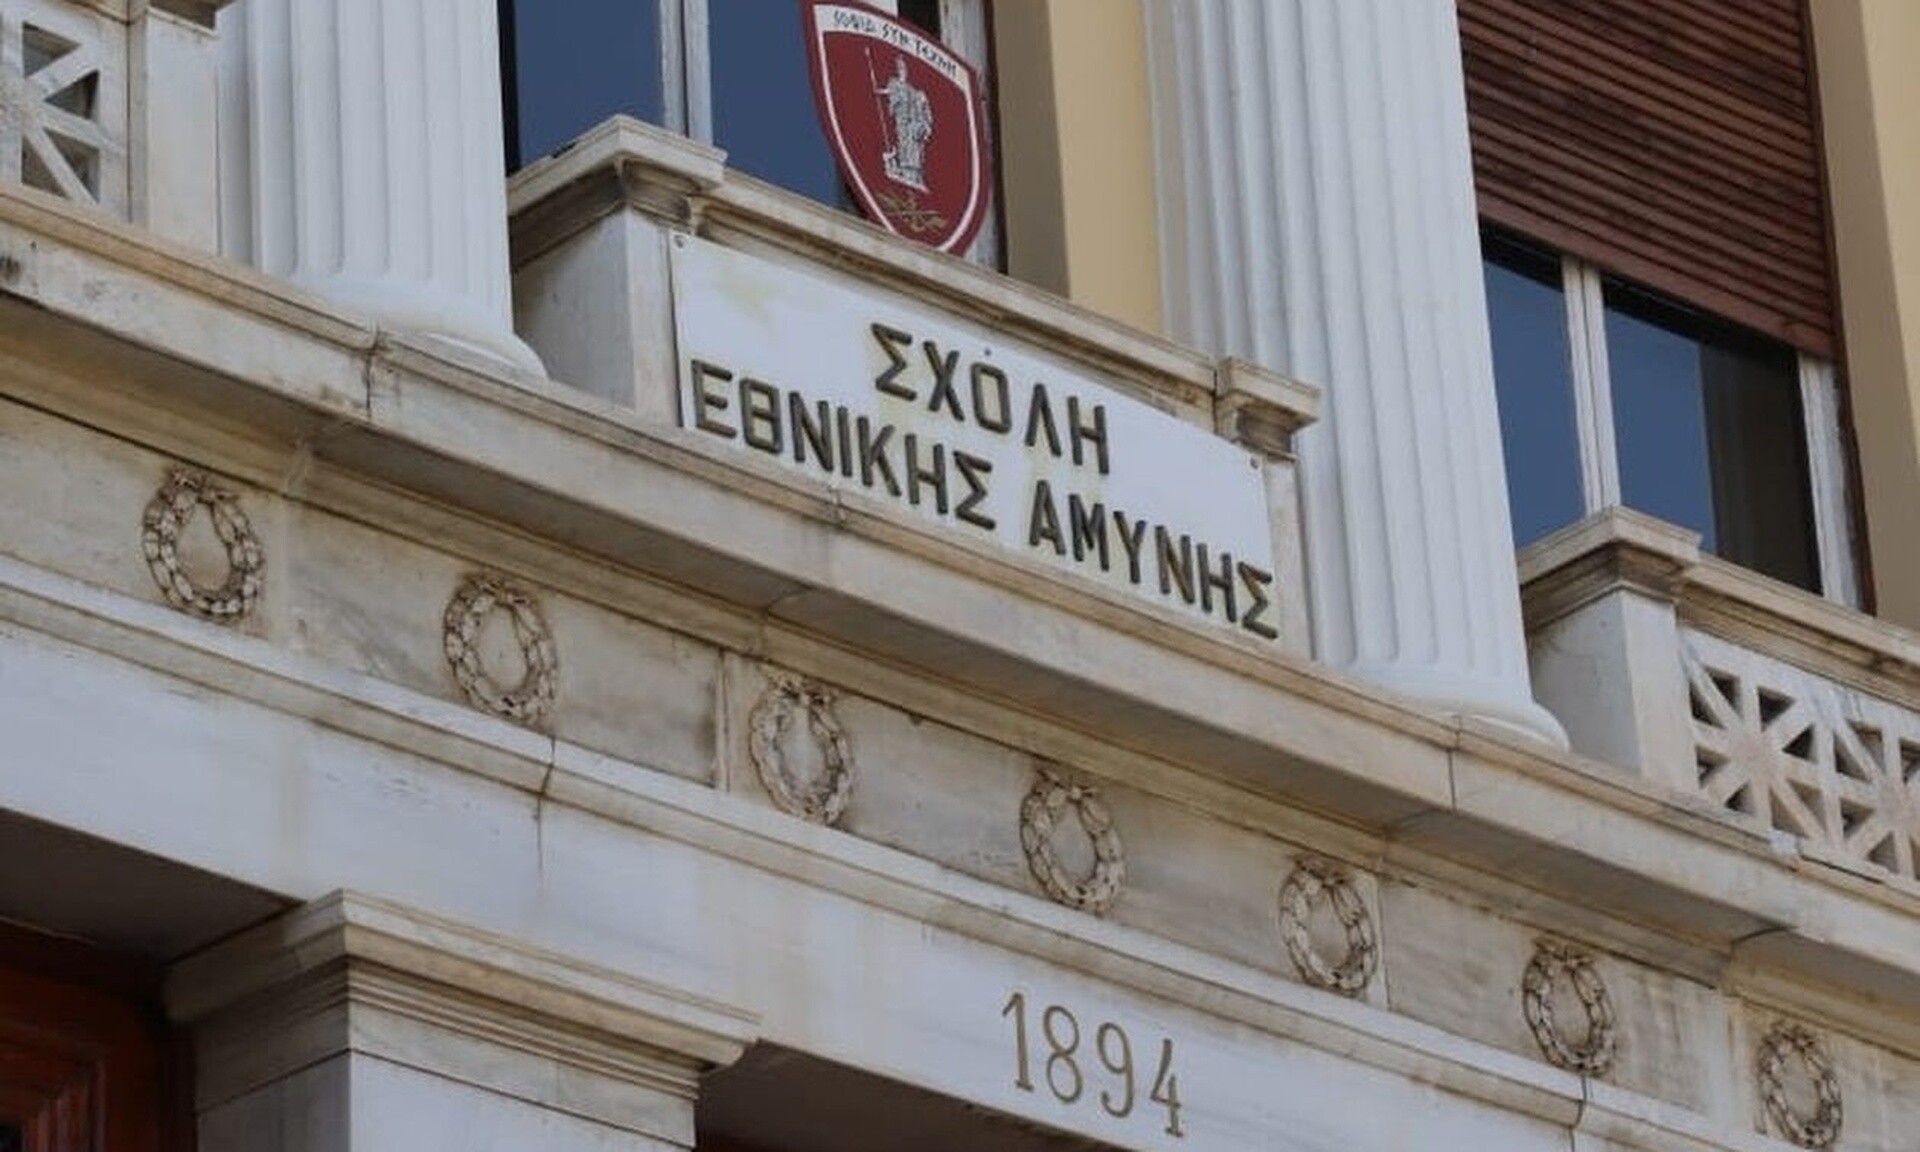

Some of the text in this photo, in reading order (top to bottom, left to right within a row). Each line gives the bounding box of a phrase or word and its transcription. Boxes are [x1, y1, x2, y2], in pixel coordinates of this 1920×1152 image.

[871, 323, 1110, 475] ΣΧΟΛΗ
[691, 358, 1279, 639] ΕΘΝΙΚΗΣ ΑΜΥΝΗΣ
[1002, 993, 1183, 1138] 1894
